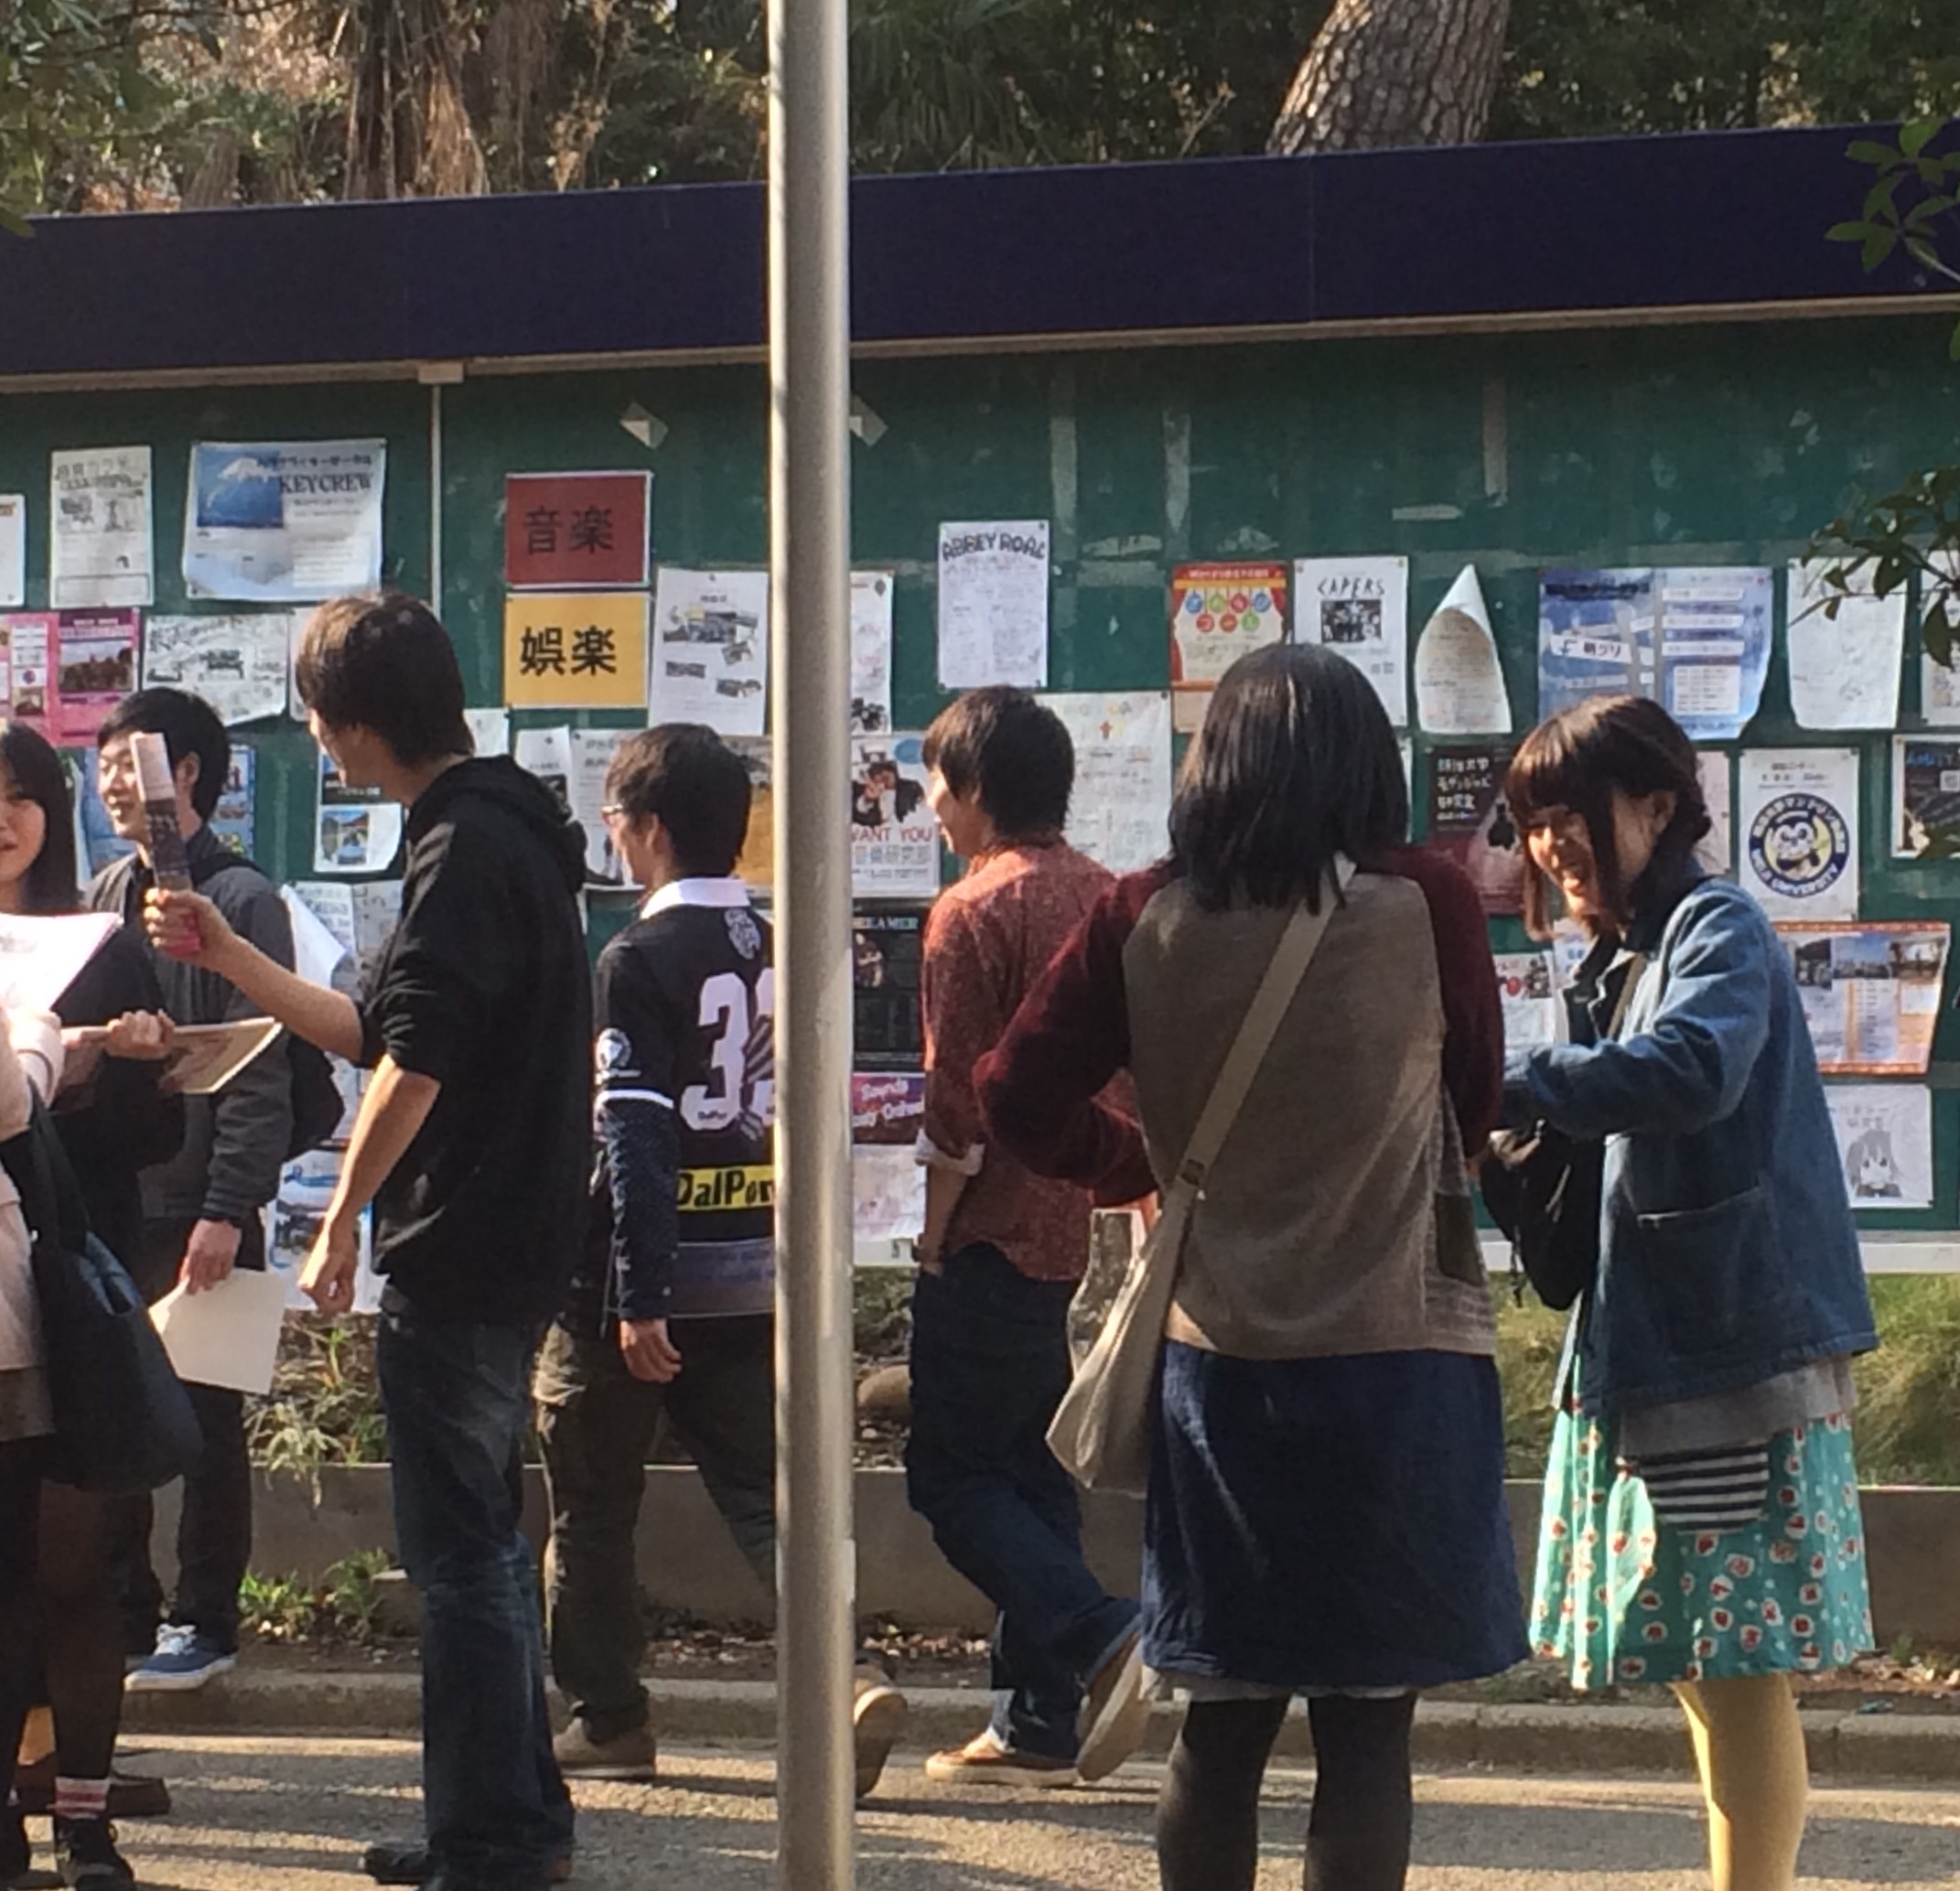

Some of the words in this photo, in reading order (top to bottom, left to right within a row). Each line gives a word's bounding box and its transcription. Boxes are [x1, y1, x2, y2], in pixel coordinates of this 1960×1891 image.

[523, 505, 613, 555] 音楽
[1317, 575, 1384, 600] CAPERS
[520, 625, 617, 676] 娯楽
[899, 825, 933, 843] YOU
